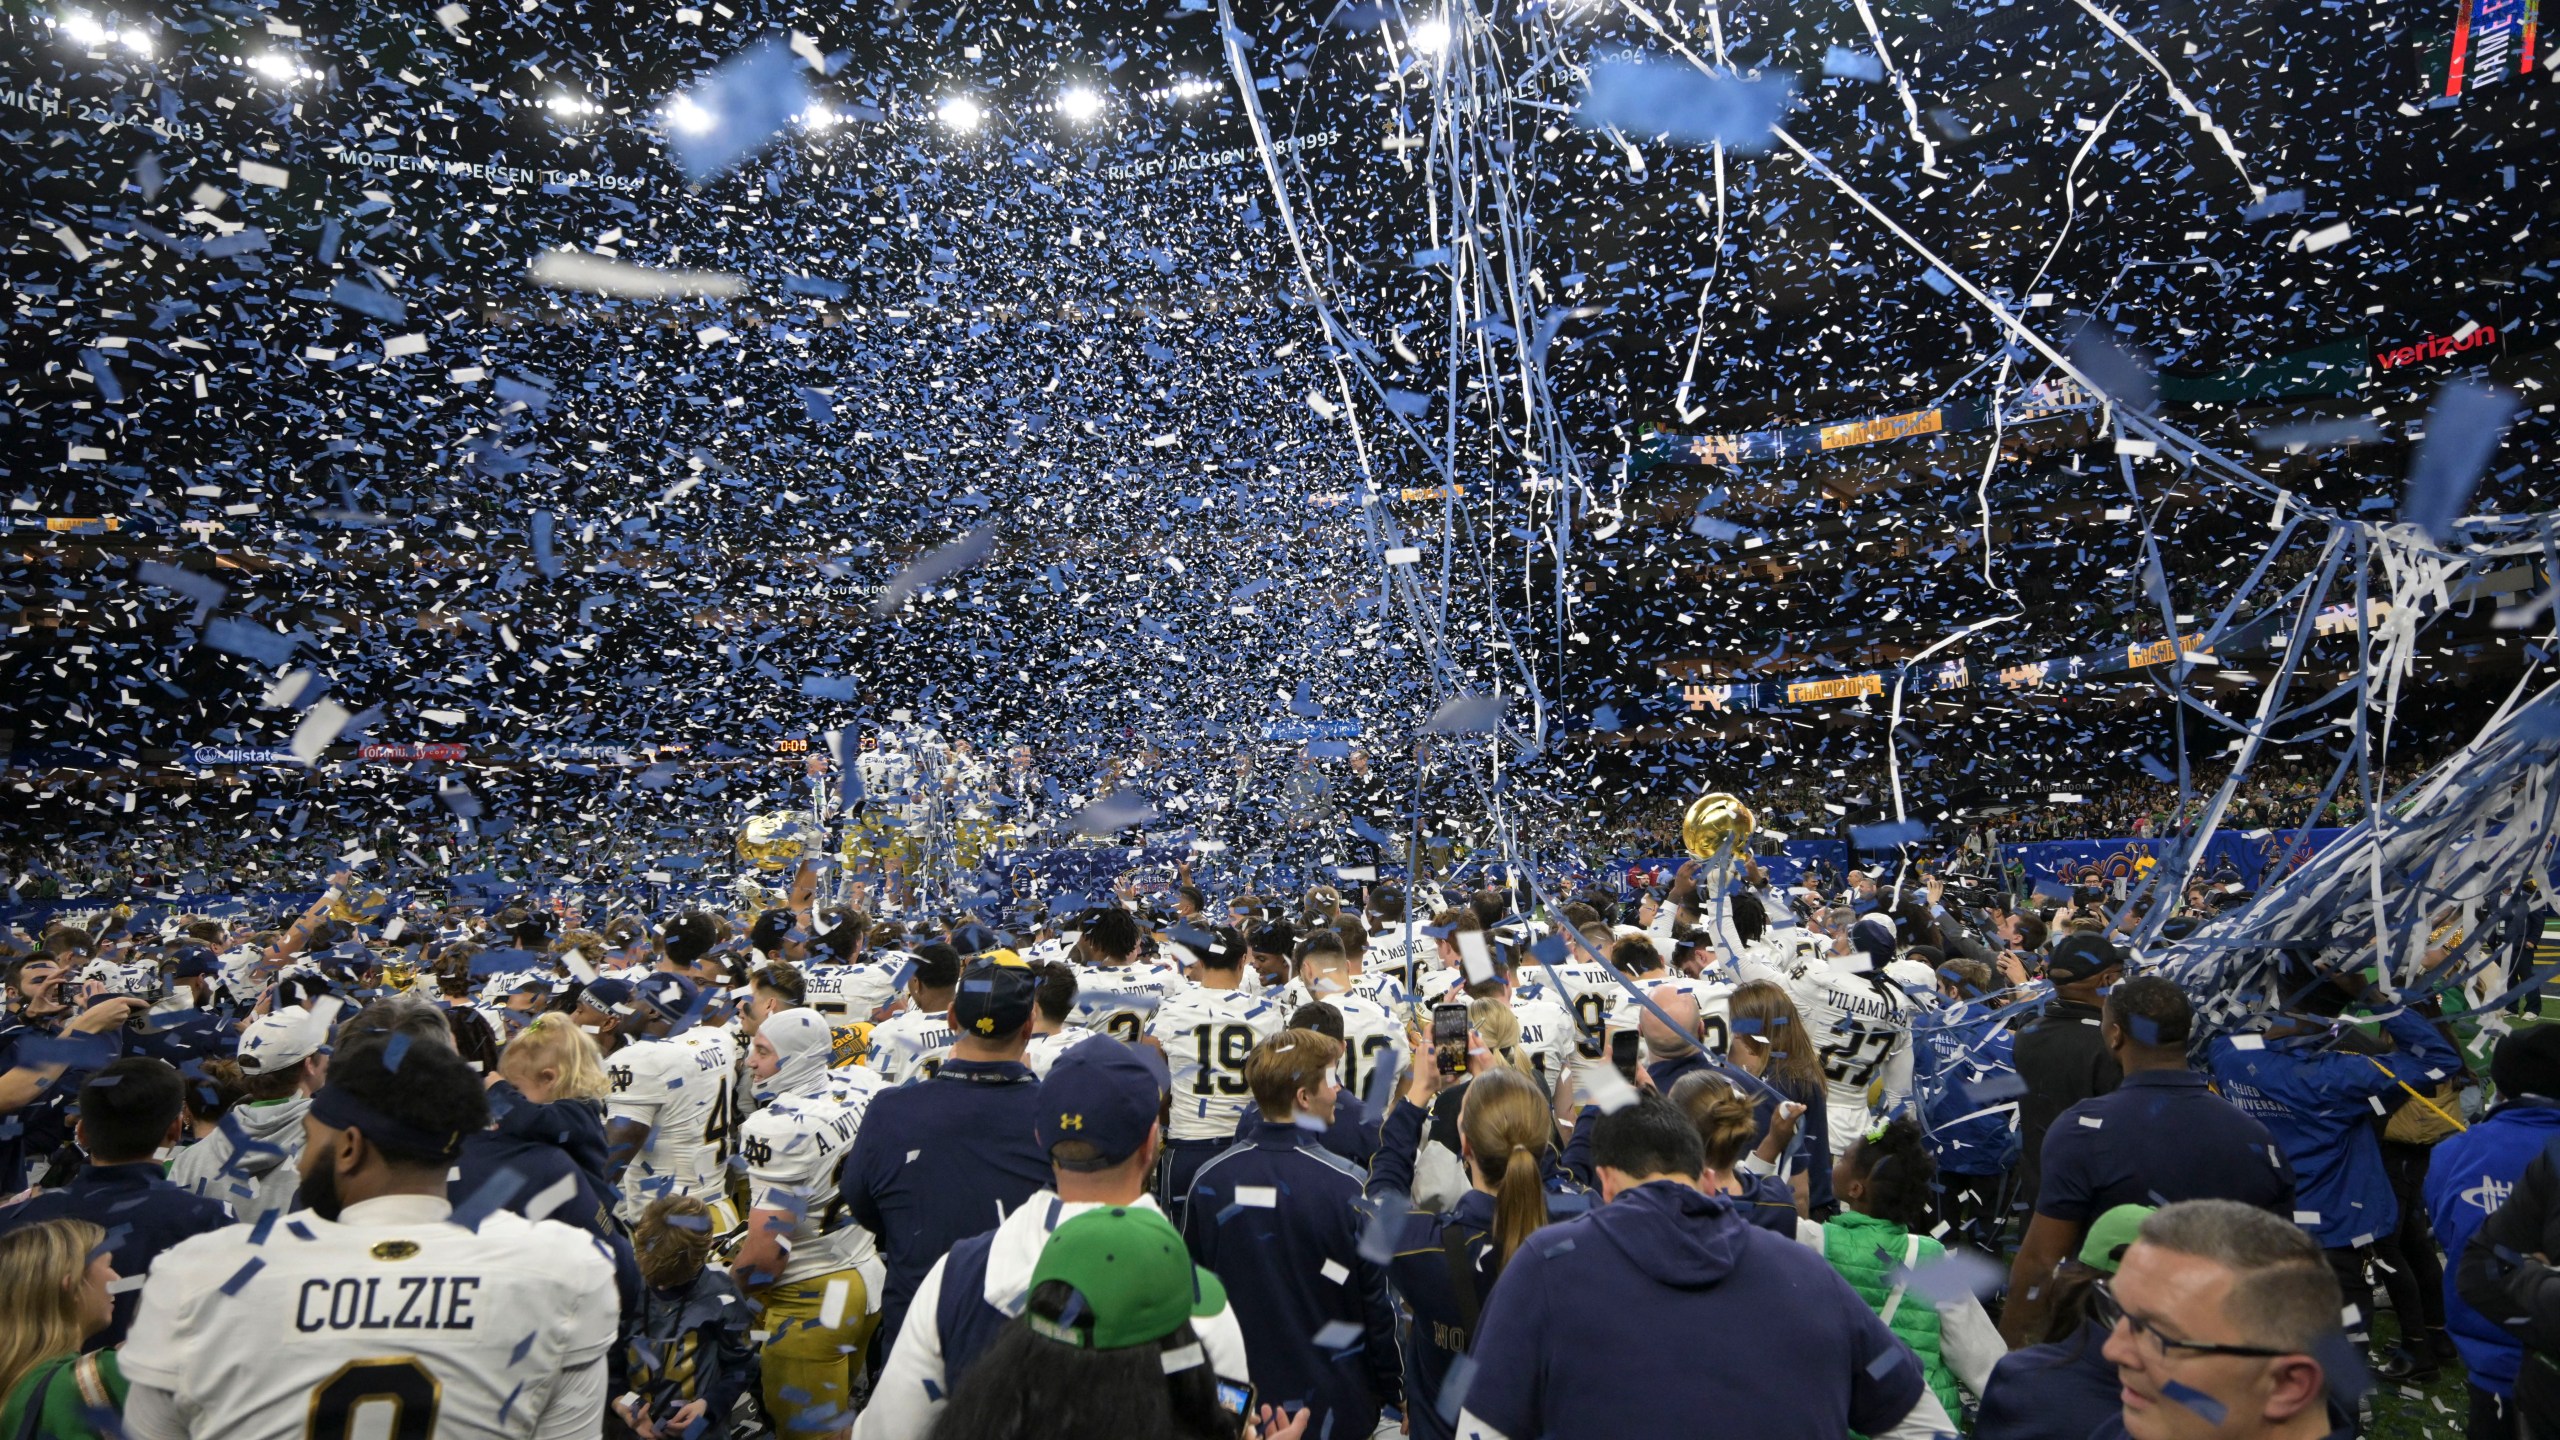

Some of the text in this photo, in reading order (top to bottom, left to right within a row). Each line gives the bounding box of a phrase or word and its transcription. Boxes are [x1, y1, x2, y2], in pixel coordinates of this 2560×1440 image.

[1169, 147, 1246, 173] JACKSON
[2377, 325, 2497, 370] verizon
[1830, 412, 1933, 447] CHAMPIONS
[1792, 677, 1875, 701] CHAMPIONS
[2037, 782, 2095, 794] SUPERDOM
[1193, 1023, 1256, 1096] 19
[1819, 1017, 1898, 1087] 27
[704, 1074, 731, 1168] 4
[815, 1130, 836, 1158] A.
[295, 1276, 481, 1334] COLZIE
